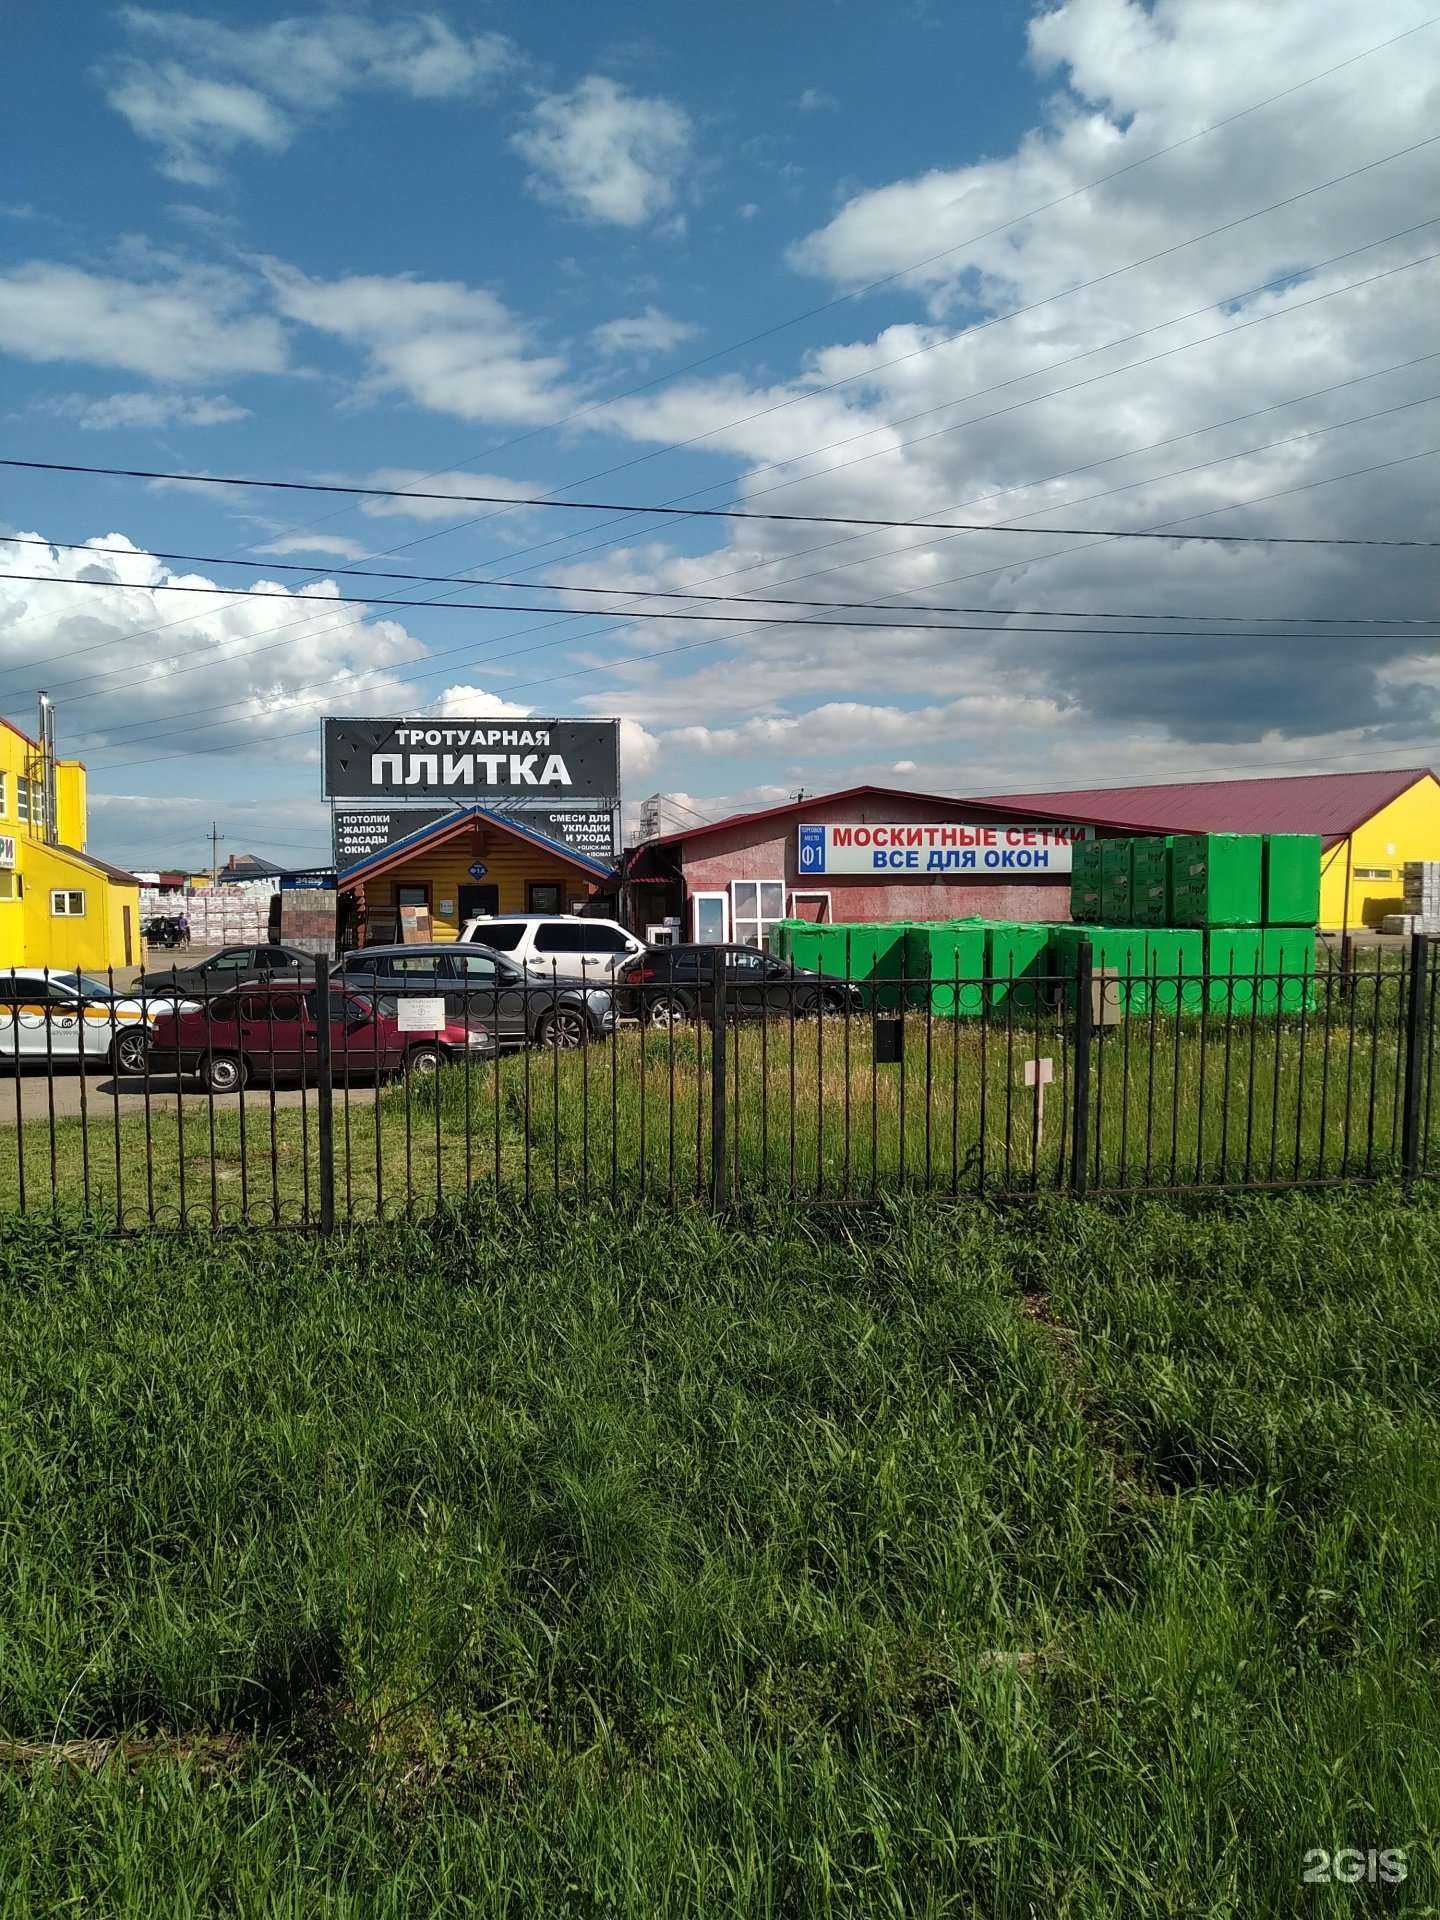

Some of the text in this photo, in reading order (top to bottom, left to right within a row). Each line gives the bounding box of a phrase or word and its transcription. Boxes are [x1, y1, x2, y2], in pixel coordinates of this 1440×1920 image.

[395, 729, 550, 746] ТРОТУАРНАЯ
[371, 754, 572, 785] ПЛИТКА
[343, 814, 390, 824] ПОТОЛКИ
[549, 814, 611, 823] СМЕСИ ДЛЯ
[343, 825, 389, 834] ЖАЛЮЗИ
[562, 824, 611, 833] УКЛАДКИ
[343, 835, 388, 845] ФАСАДЫ
[565, 833, 611, 843] И УХОДА
[832, 827, 1086, 847] МОСКИТНЫЕ СЕТКИ
[343, 845, 371, 854] ОКНА
[801, 845, 822, 866] Ф1
[873, 849, 1049, 871] ВСЕ ДЛЯ ОКОН
